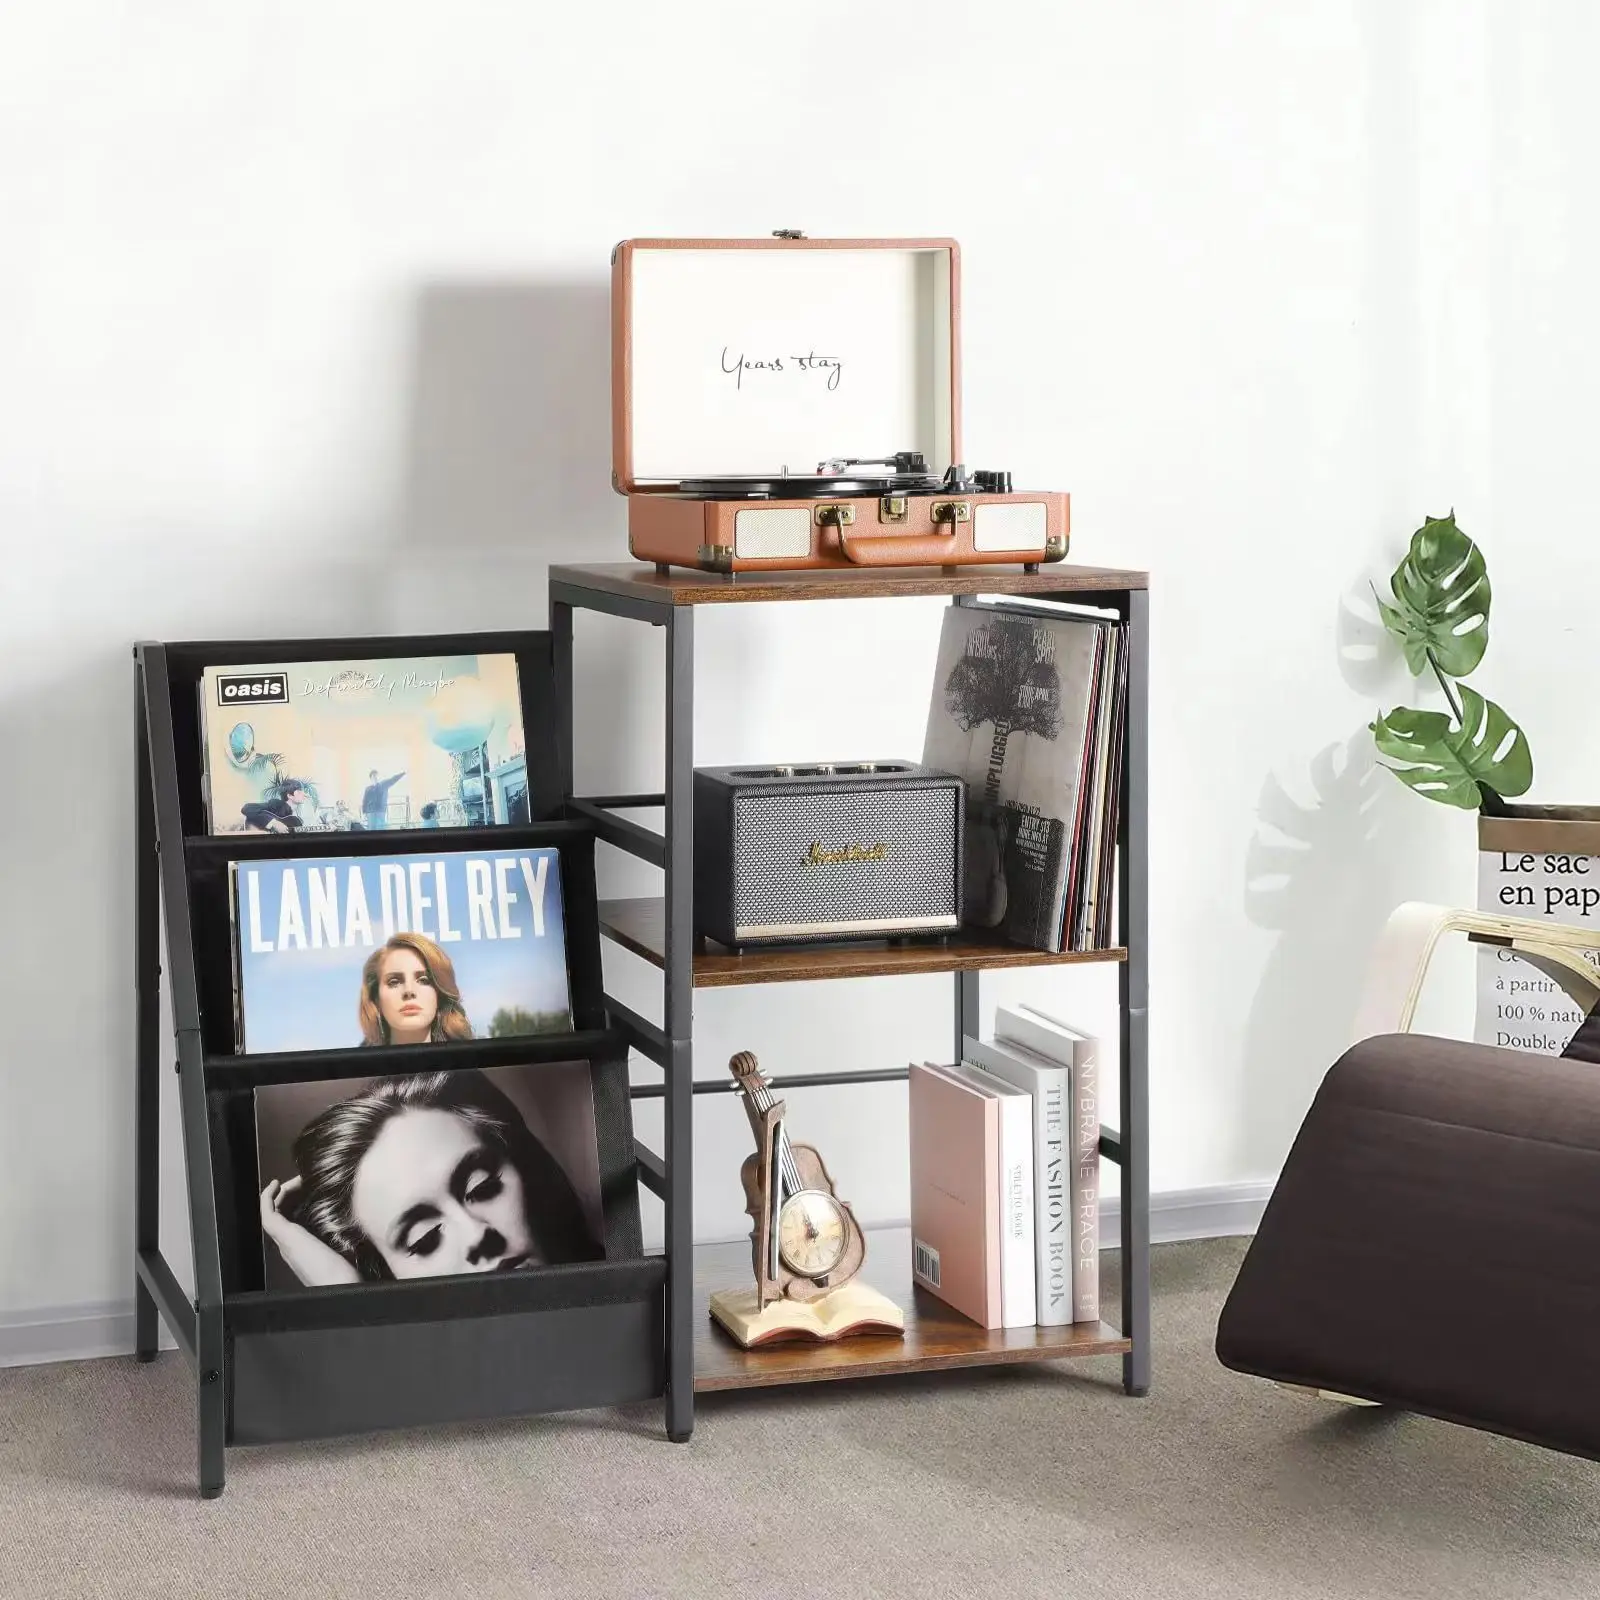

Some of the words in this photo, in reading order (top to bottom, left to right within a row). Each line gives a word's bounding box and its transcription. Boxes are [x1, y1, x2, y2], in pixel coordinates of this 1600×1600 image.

[721, 346, 784, 391] Years
[790, 350, 840, 391] stay
[224, 679, 282, 697] oasis
[402, 668, 456, 697] Maybe
[983, 718, 1010, 804] UNPLUGGED
[1500, 852, 1535, 873] Le
[1543, 854, 1591, 875] sac
[247, 866, 375, 953] LANA
[379, 861, 462, 945] DEL
[465, 856, 549, 941] REY
[1499, 885, 1536, 905] en
[1496, 976, 1504, 990] à
[1510, 978, 1557, 995] partir
[1497, 1005, 1524, 1019] 100
[1530, 1007, 1545, 1021] %
[1497, 1032, 1556, 1050] Double
[1047, 1084, 1061, 1133] THE
[1080, 1054, 1096, 1178] WYBRANE
[1047, 1137, 1063, 1233] FASHION
[1080, 1188, 1096, 1272] PRACE
[1049, 1242, 1065, 1307] BOOK
